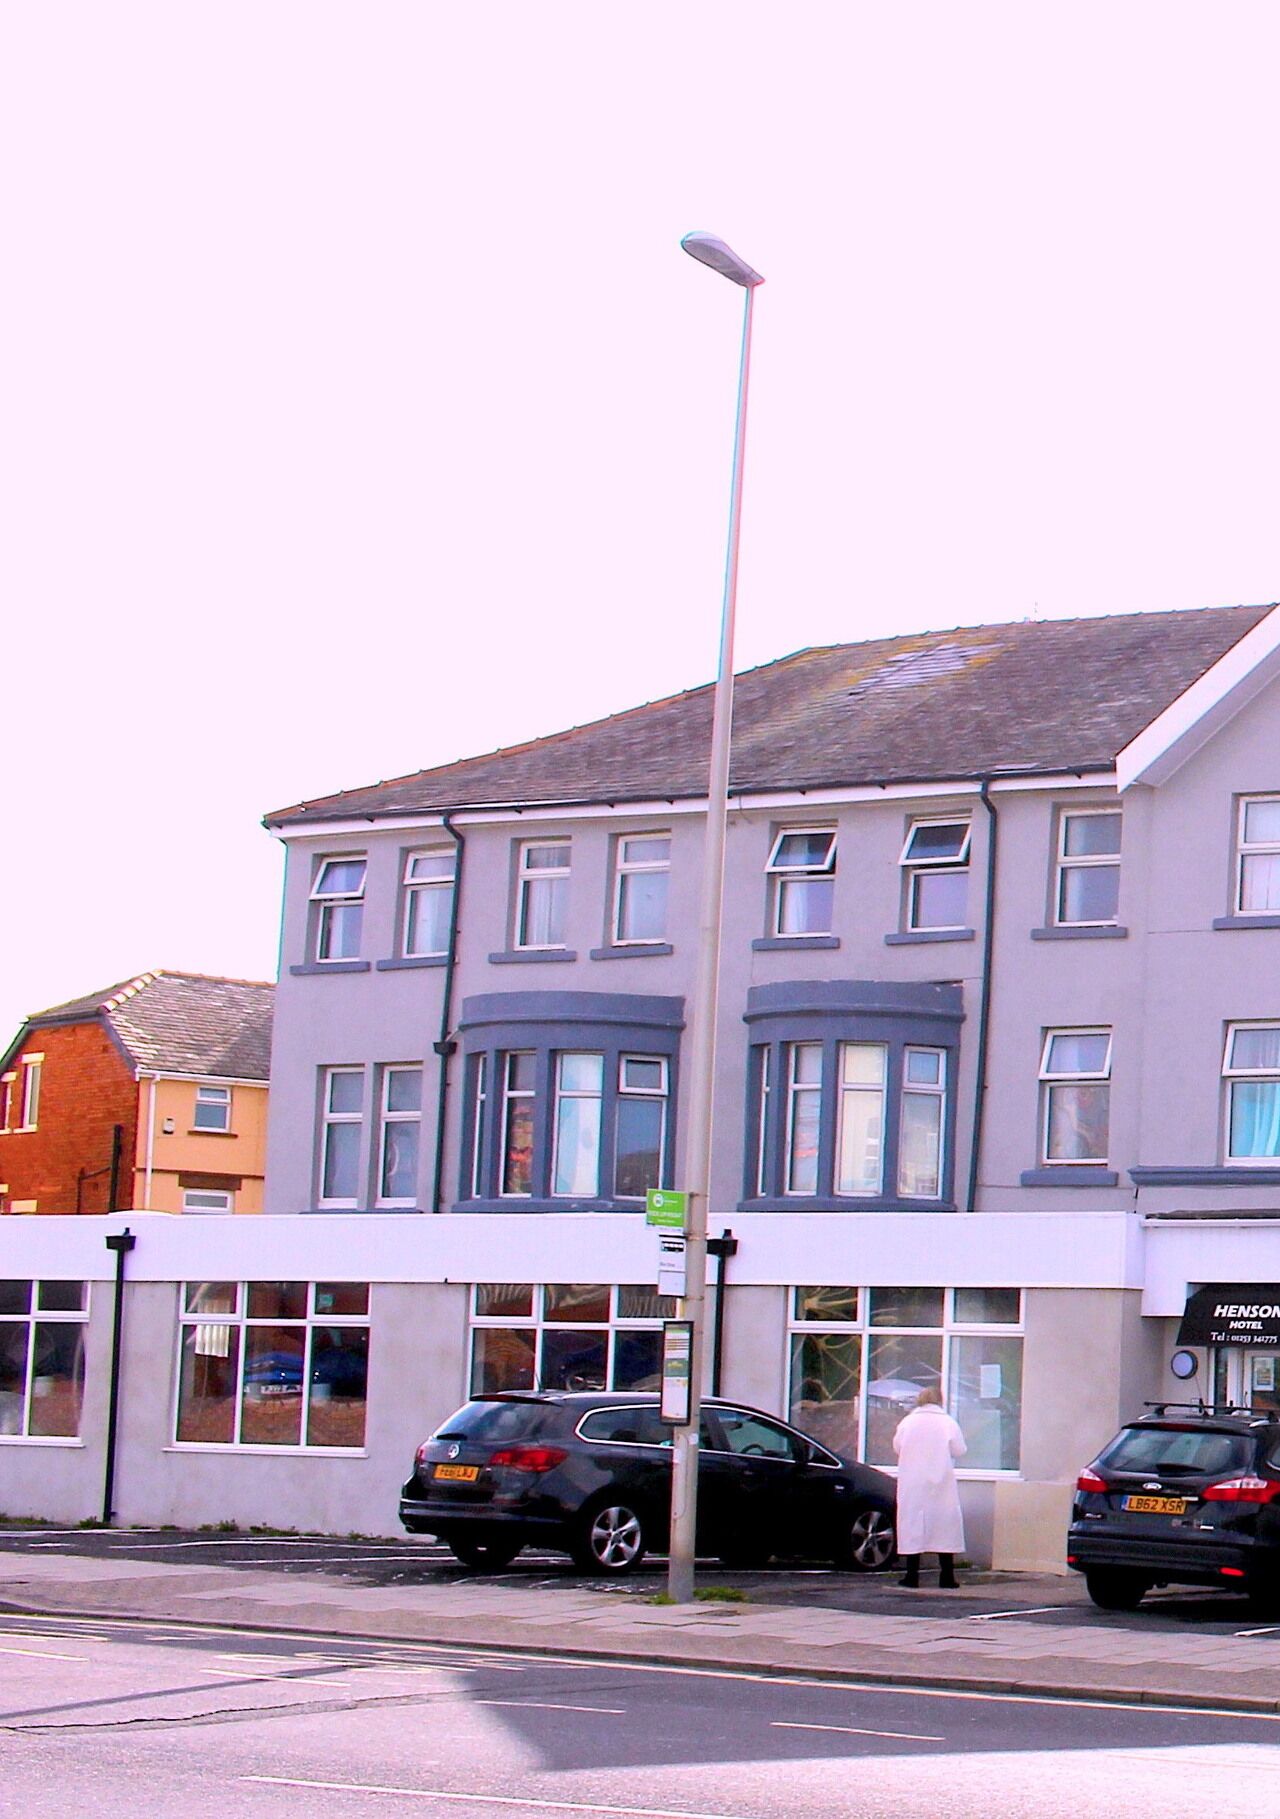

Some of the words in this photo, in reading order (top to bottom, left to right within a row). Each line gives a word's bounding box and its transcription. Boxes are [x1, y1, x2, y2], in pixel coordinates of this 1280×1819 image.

[1229, 1320, 1263, 1329] HOTEL
[1128, 1498, 1158, 1510] LB62
[1160, 1500, 1184, 1512] XSR
